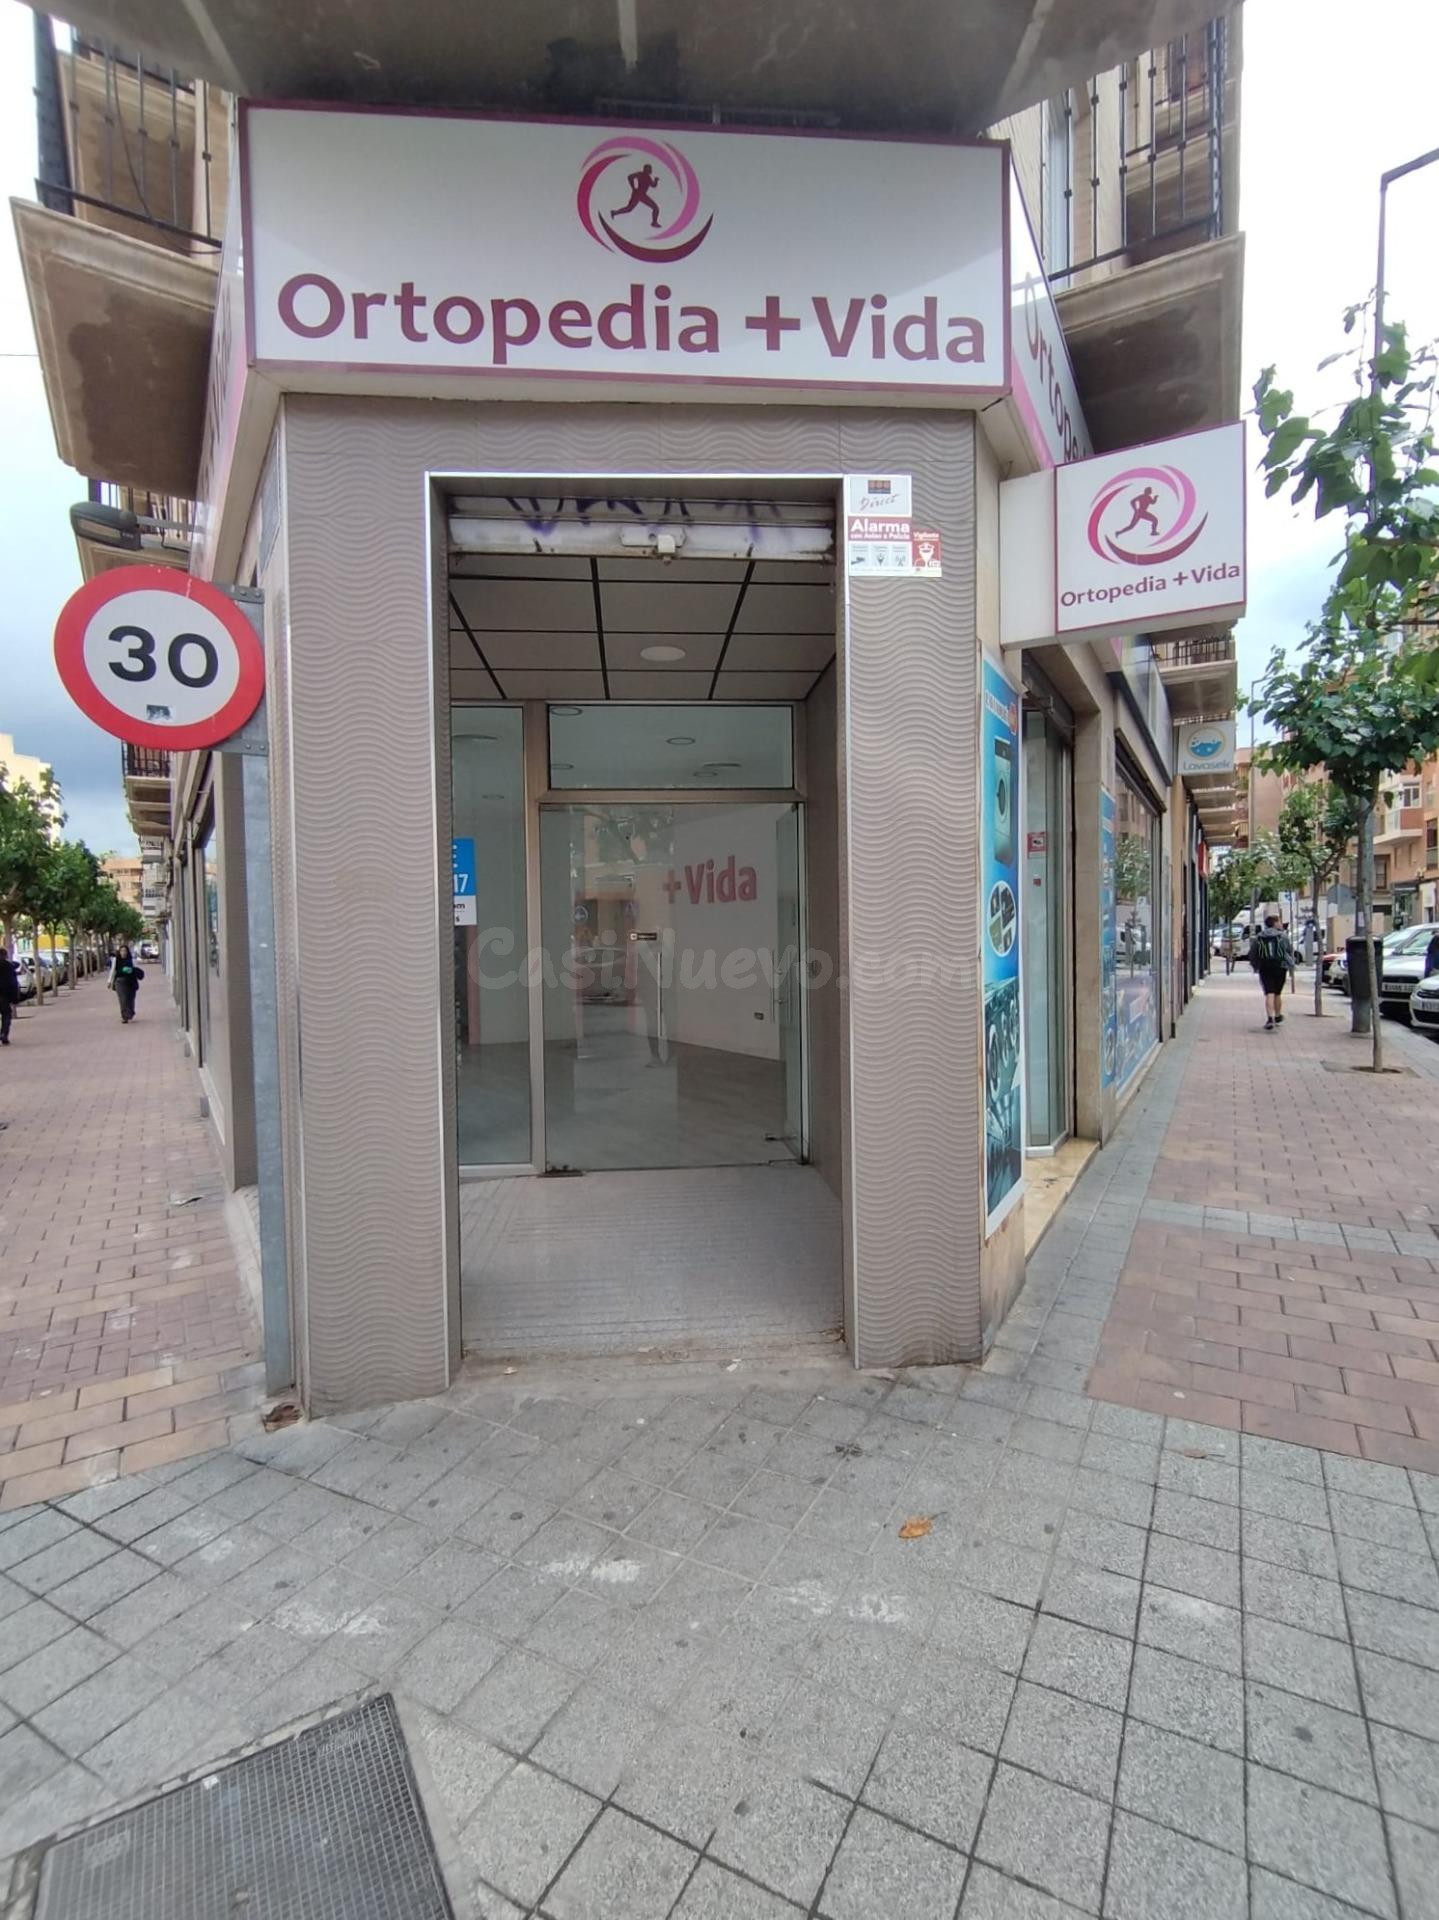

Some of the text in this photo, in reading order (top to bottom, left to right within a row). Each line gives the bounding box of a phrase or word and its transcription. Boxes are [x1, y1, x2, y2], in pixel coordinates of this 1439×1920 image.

[278, 272, 719, 366] Ortopedia
[850, 518, 910, 533] Alarma
[1060, 576, 1167, 608] Ortopedia
[107, 624, 219, 689] 30
